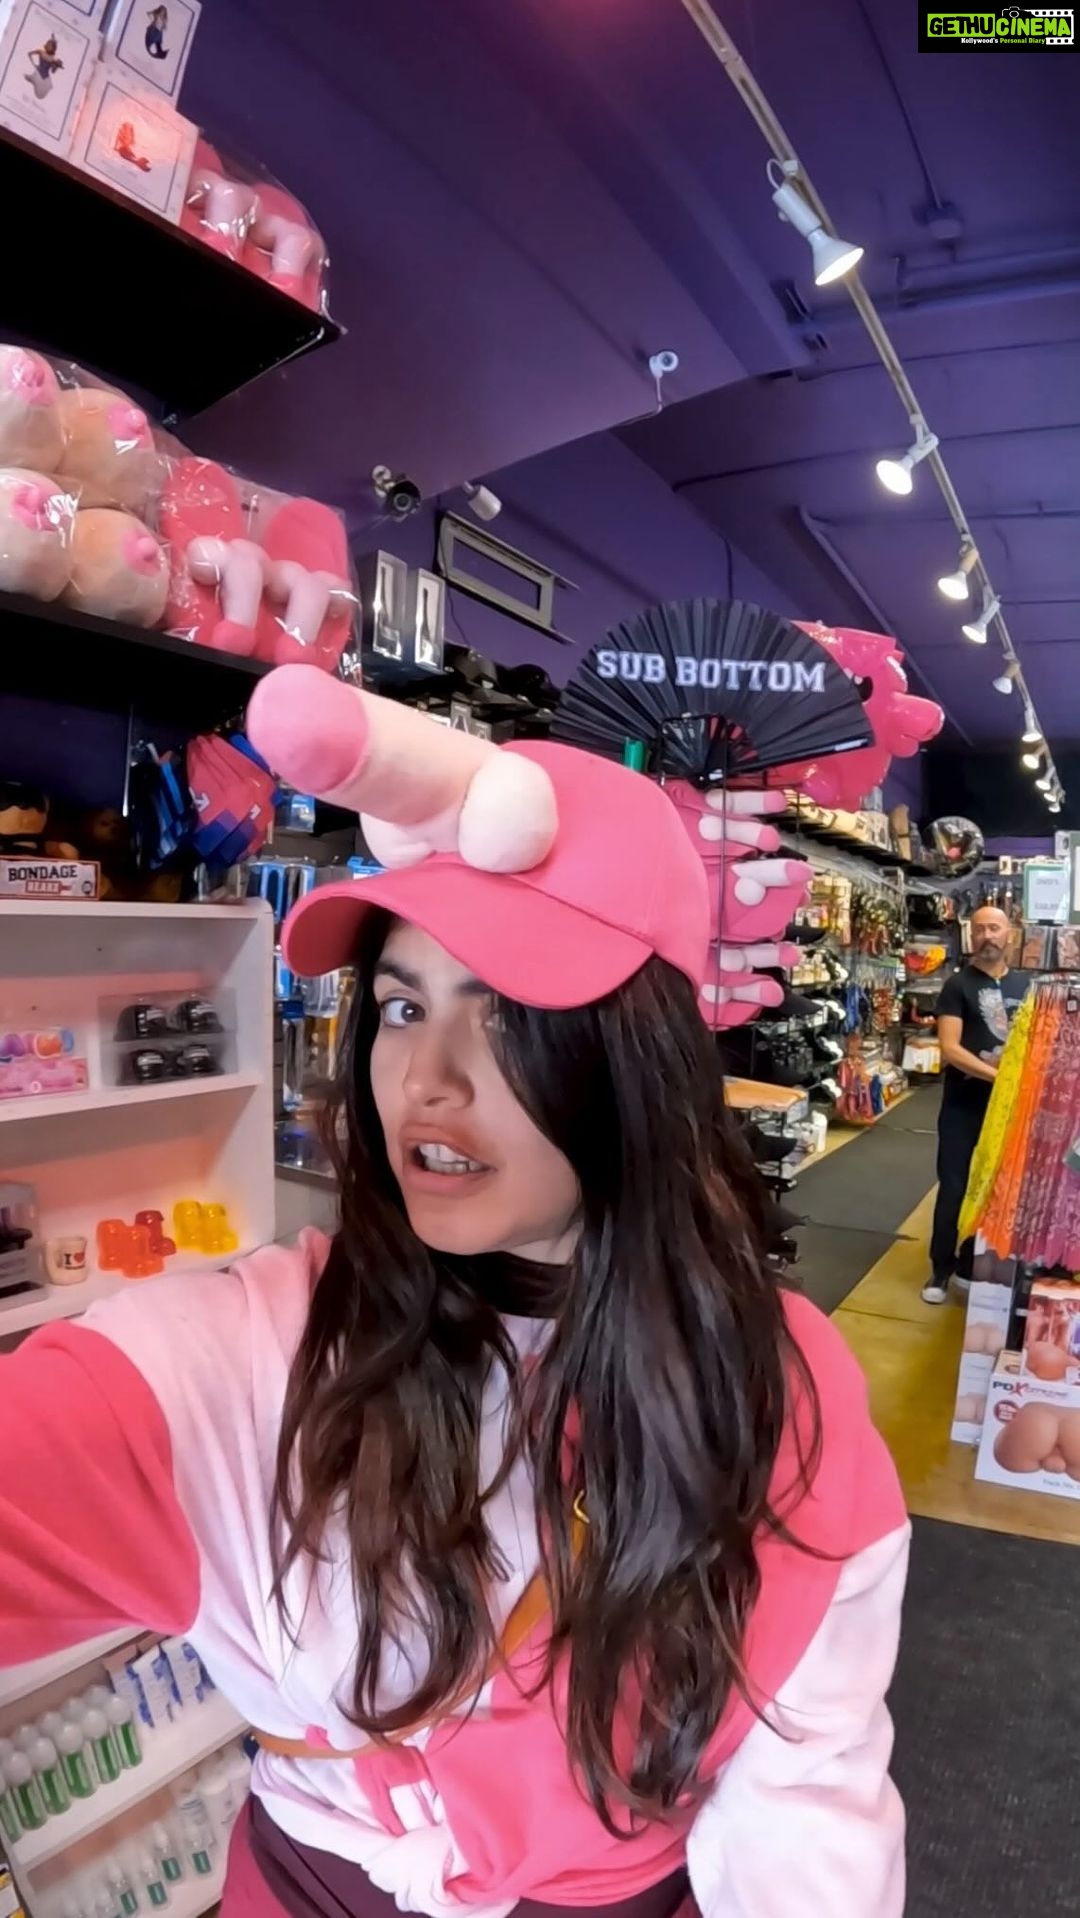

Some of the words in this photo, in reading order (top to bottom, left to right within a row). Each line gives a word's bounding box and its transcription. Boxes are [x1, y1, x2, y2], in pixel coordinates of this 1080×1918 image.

[596, 650, 666, 683] SUB
[674, 655, 826, 692] BOTTOM
[8, 865, 78, 881] BONDAGE
